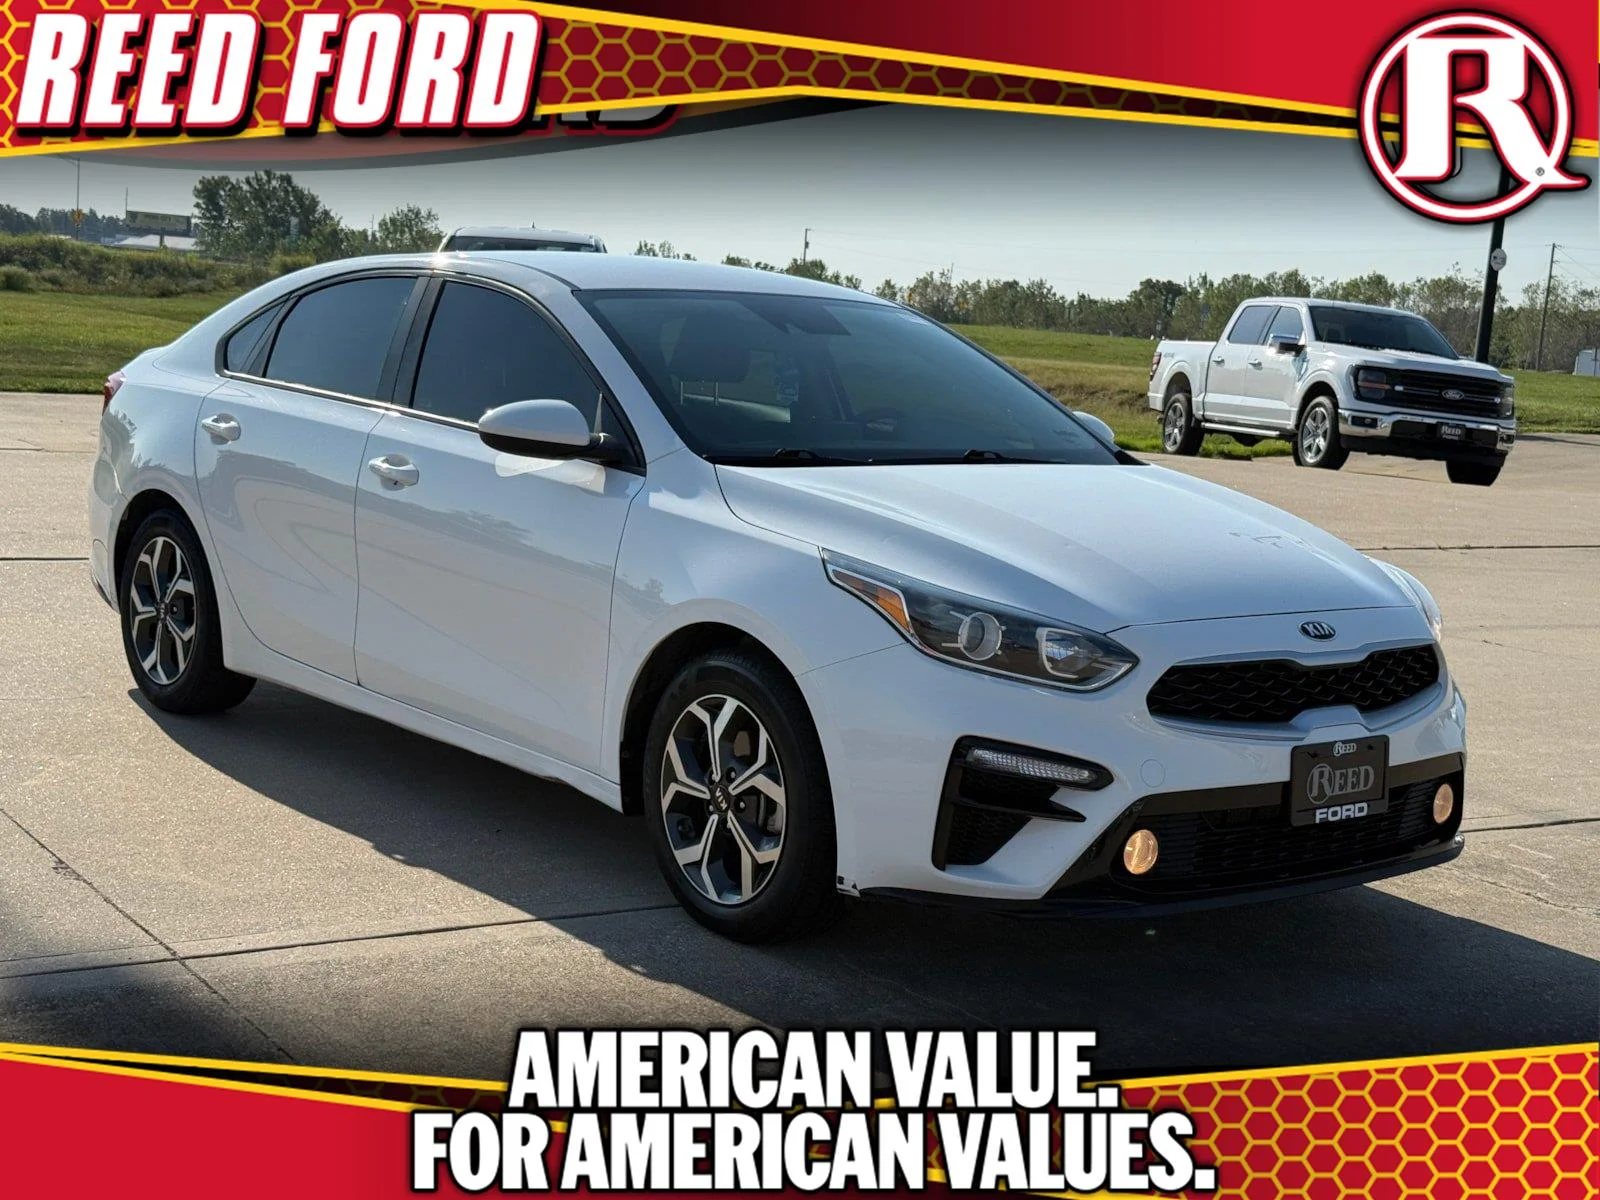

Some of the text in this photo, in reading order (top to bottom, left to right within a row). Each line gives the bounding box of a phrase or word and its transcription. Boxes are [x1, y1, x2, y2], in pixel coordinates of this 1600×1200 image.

[1302, 622, 1335, 637] KIA
[1333, 742, 1357, 756] REED
[1308, 764, 1375, 801] REED
[1315, 802, 1368, 823] FORD
